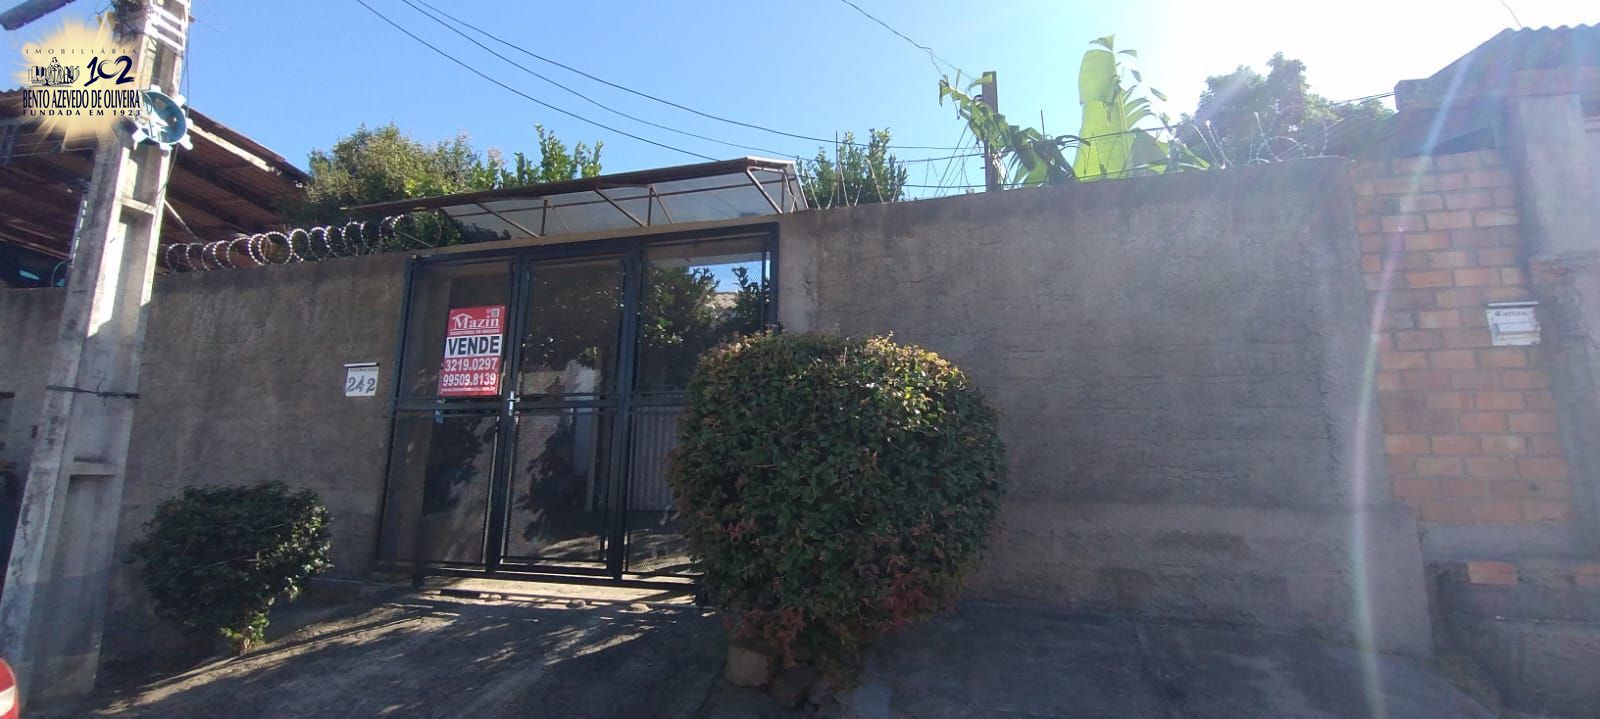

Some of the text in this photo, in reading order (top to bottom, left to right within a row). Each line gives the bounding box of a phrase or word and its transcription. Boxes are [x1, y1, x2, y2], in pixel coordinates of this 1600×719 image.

[453, 314, 500, 330] Mazin
[448, 336, 500, 356] VENDE
[445, 358, 498, 372] 3219.0297
[348, 376, 376, 394] 242
[442, 372, 496, 387] 99509.8139
